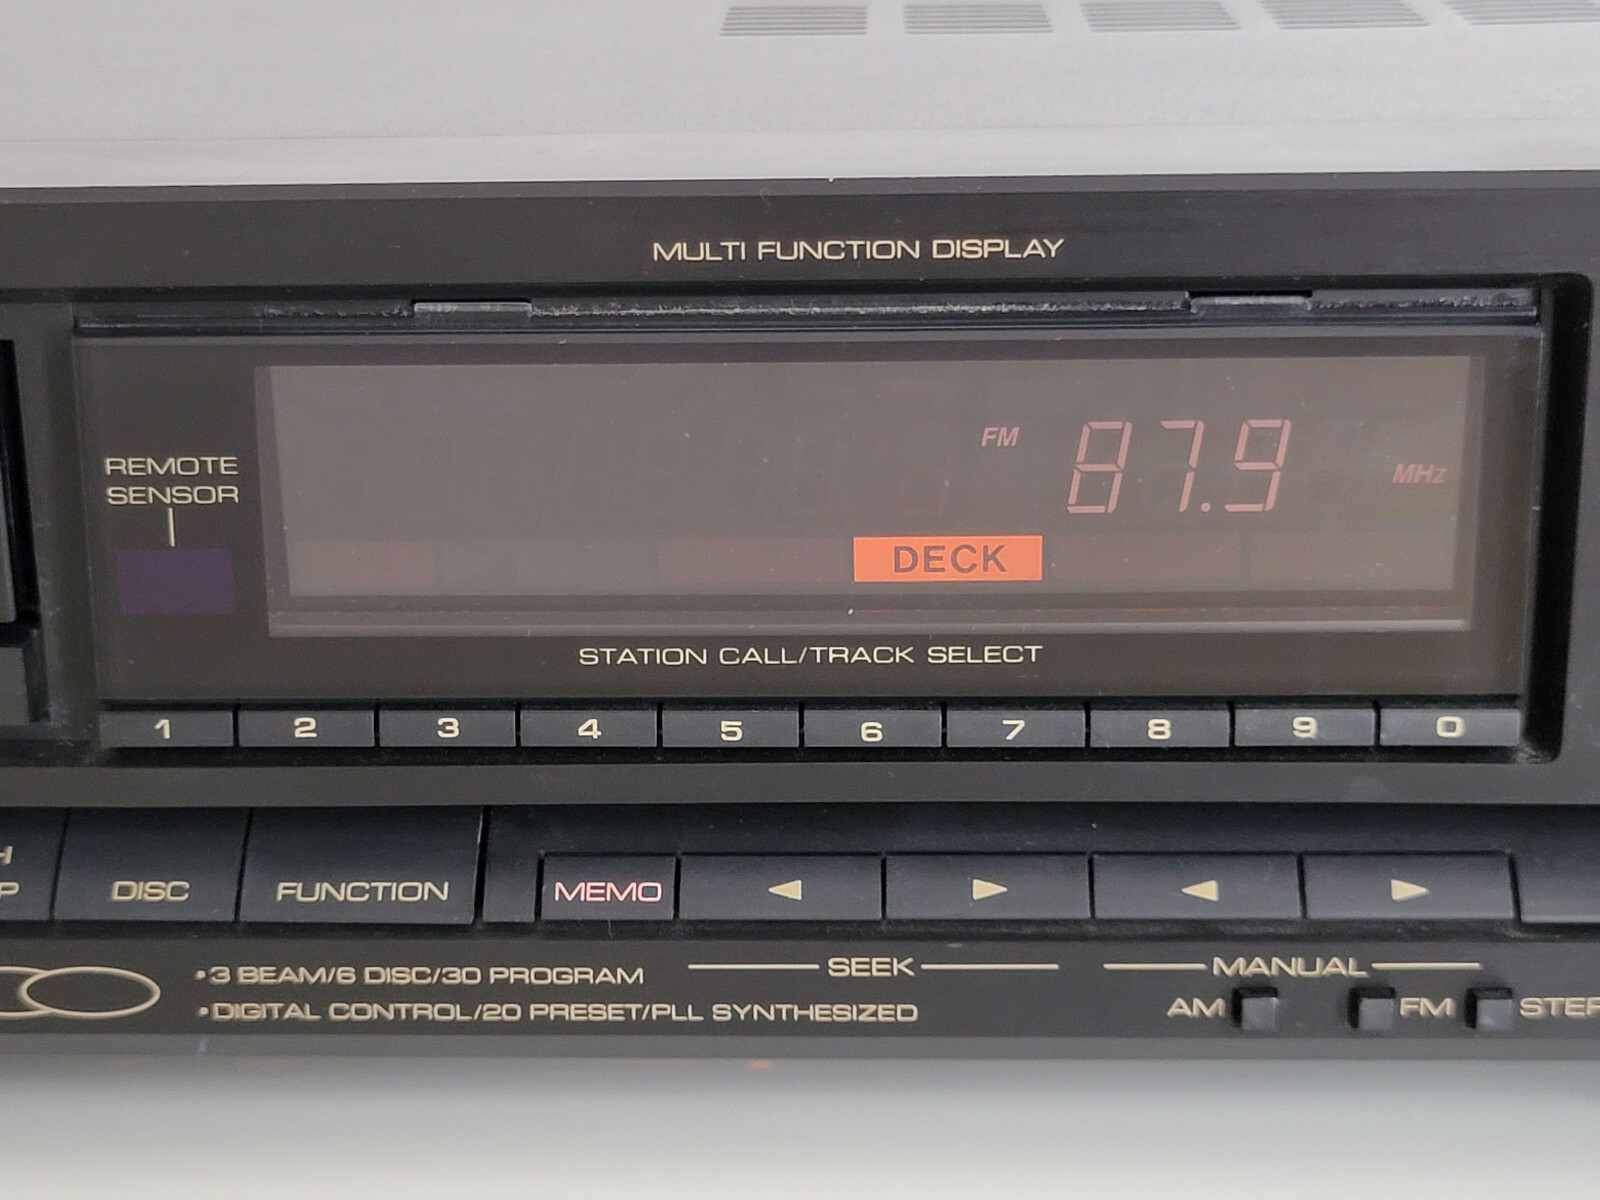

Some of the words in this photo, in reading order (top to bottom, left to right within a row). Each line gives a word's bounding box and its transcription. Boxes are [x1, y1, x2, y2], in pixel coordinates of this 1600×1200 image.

[653, 241, 746, 262] MULTI
[757, 240, 920, 261] FUNCTION
[932, 238, 1064, 259] DISPLAY
[981, 426, 1020, 447] FM
[105, 456, 239, 476] REMOTE
[1067, 418, 1292, 514] 87.9
[1392, 463, 1447, 484] MHz
[106, 485, 239, 505] SENSOR
[892, 545, 1006, 574] DECK
[579, 647, 707, 666] STATION
[719, 646, 915, 665] CALL/TRACK
[927, 645, 1043, 664] SELECT
[154, 719, 171, 740] 1
[294, 717, 318, 738] 2
[437, 717, 460, 738] 3
[578, 718, 602, 739] 4
[720, 720, 743, 741] 5
[860, 721, 883, 742] 6
[1002, 719, 1026, 741] 7
[1147, 718, 1171, 740] 8
[1292, 716, 1318, 739] 9
[1436, 715, 1464, 738] 0
[111, 880, 190, 902] DISC
[276, 881, 449, 902] FUNCTION
[554, 881, 662, 902] MEMO
[237, 966, 357, 985] BEAM/6
[364, 966, 482, 985] DISC/30
[489, 967, 644, 985] PROGRAM
[827, 957, 913, 977] SEEK
[1212, 956, 1366, 977] MANUAL
[328, 1002, 522, 1021] CONTROL/20
[529, 1003, 705, 1021] PRESET/PLL
[712, 1003, 919, 1022] SYNTHESIZED
[1166, 997, 1225, 1018] AM
[1399, 997, 1454, 1017] FM
